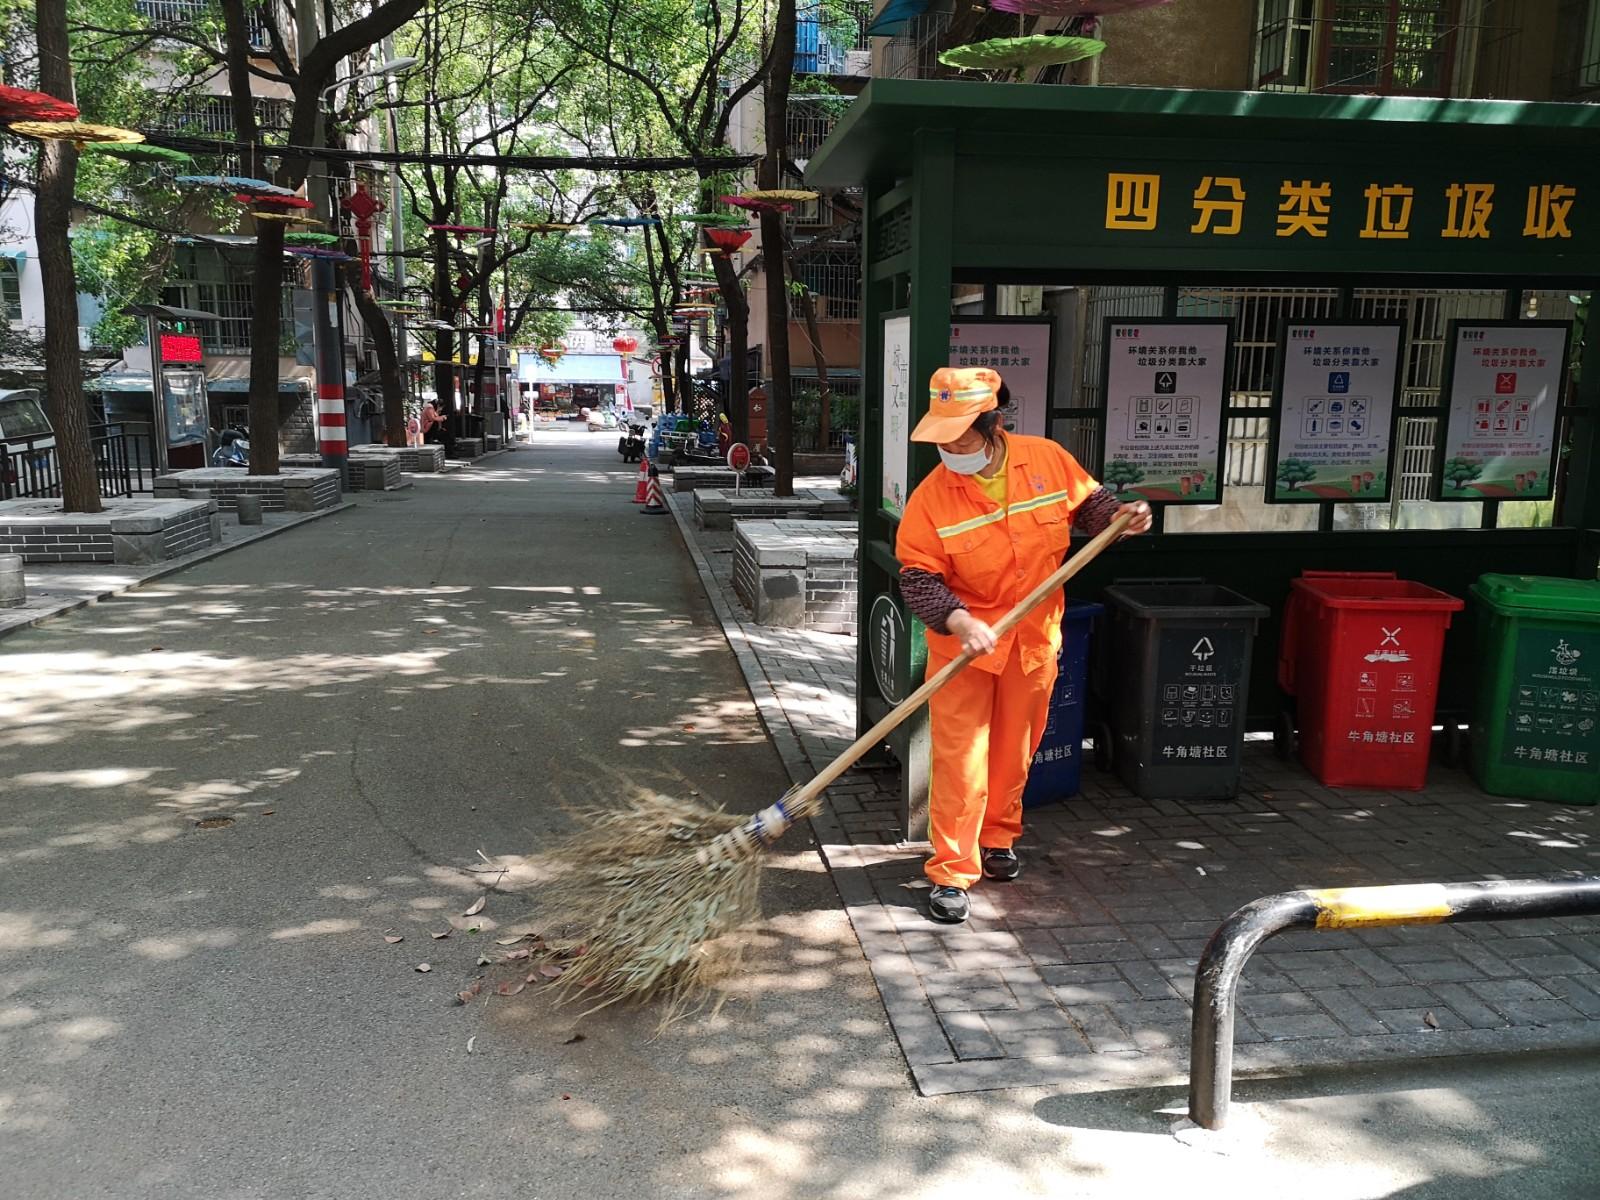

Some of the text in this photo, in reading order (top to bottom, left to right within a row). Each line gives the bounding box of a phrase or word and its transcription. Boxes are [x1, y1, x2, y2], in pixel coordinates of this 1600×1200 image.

[1105, 172, 1577, 239] 四分类垃圾收
[1128, 346, 1198, 355] 环境关系你我他
[1303, 346, 1371, 357] 环境关系你我他
[1472, 347, 1537, 357] 环境关系你我他
[959, 357, 1031, 367] 垃圾分类靠大家
[1137, 357, 1208, 367] 垃圾分类靠大家
[1312, 358, 1380, 367] 垃圾分类靠大家
[1481, 358, 1547, 368] 垃圾分类靠大家
[1347, 730, 1416, 744] 牛角塘社区
[1034, 744, 1073, 764] 角塘社区
[1162, 745, 1228, 758] 牛角塘社区
[1513, 745, 1589, 764] 牛角塘社区
